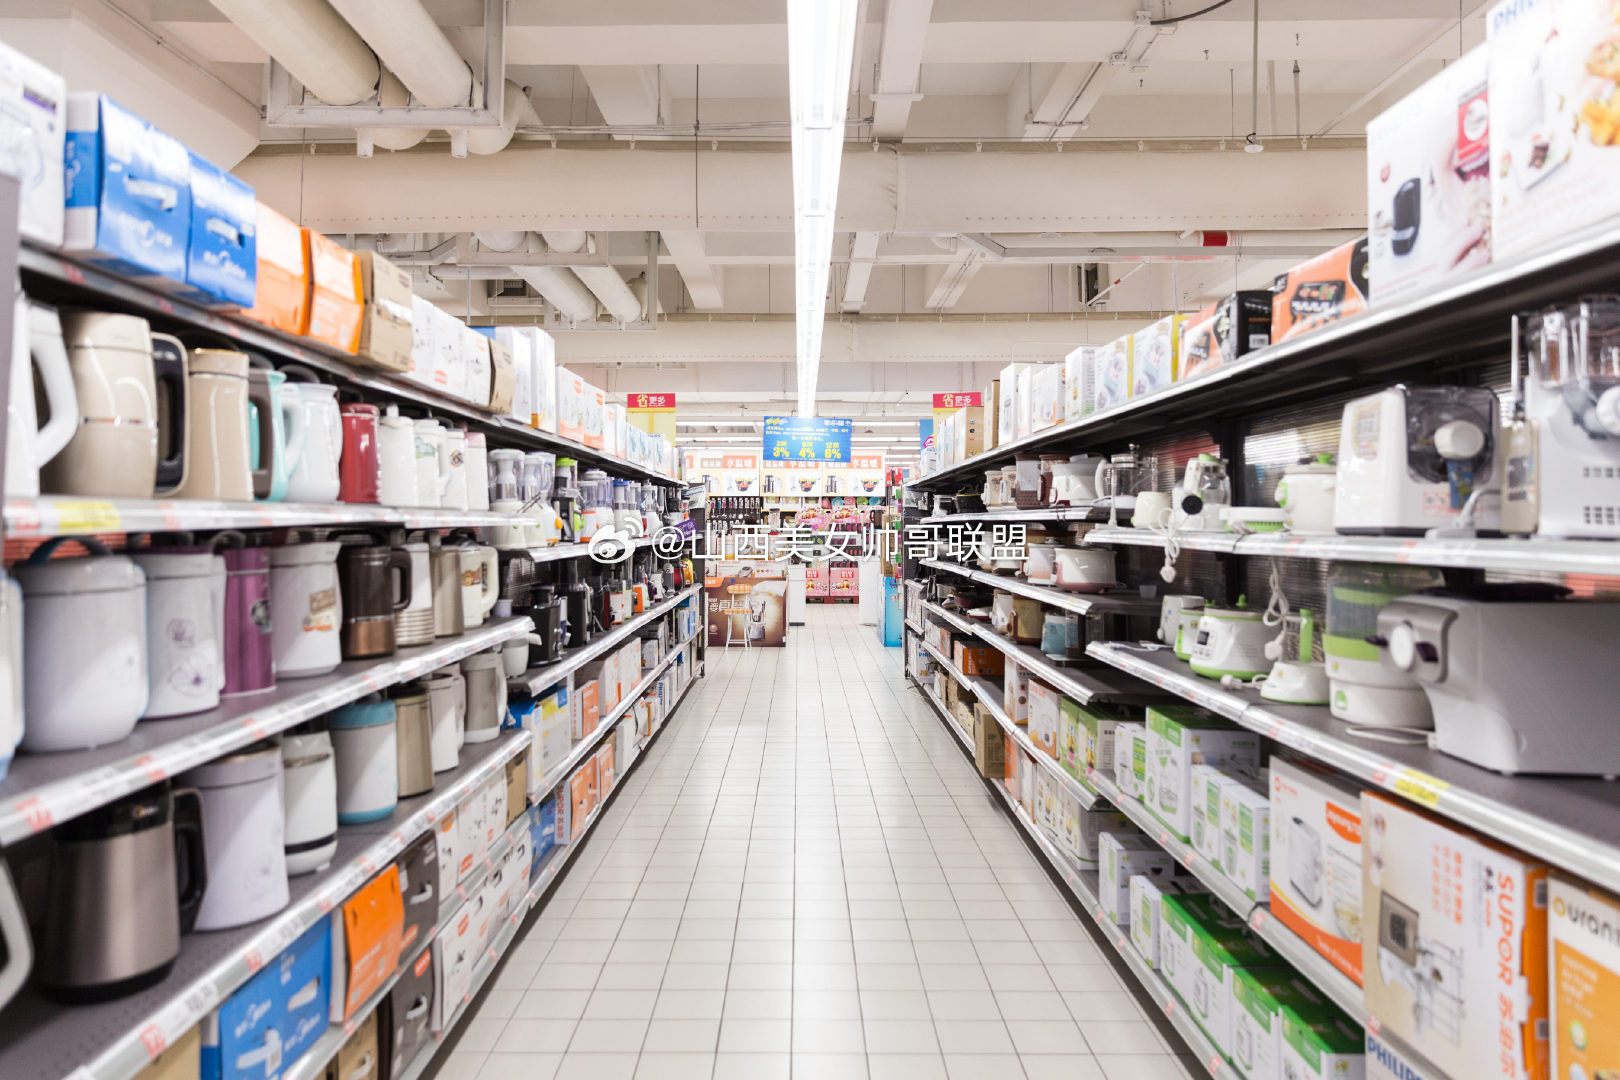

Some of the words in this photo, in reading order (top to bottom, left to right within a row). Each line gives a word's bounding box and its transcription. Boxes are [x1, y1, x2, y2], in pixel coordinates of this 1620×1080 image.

[637, 394, 665, 407] 省更多
[773, 447, 789, 458] 3%
[799, 447, 815, 458] 4%
[825, 448, 841, 459] 6%
[1497, 871, 1515, 986] SUPOR
[1498, 993, 1516, 1079] 苏泊尔
